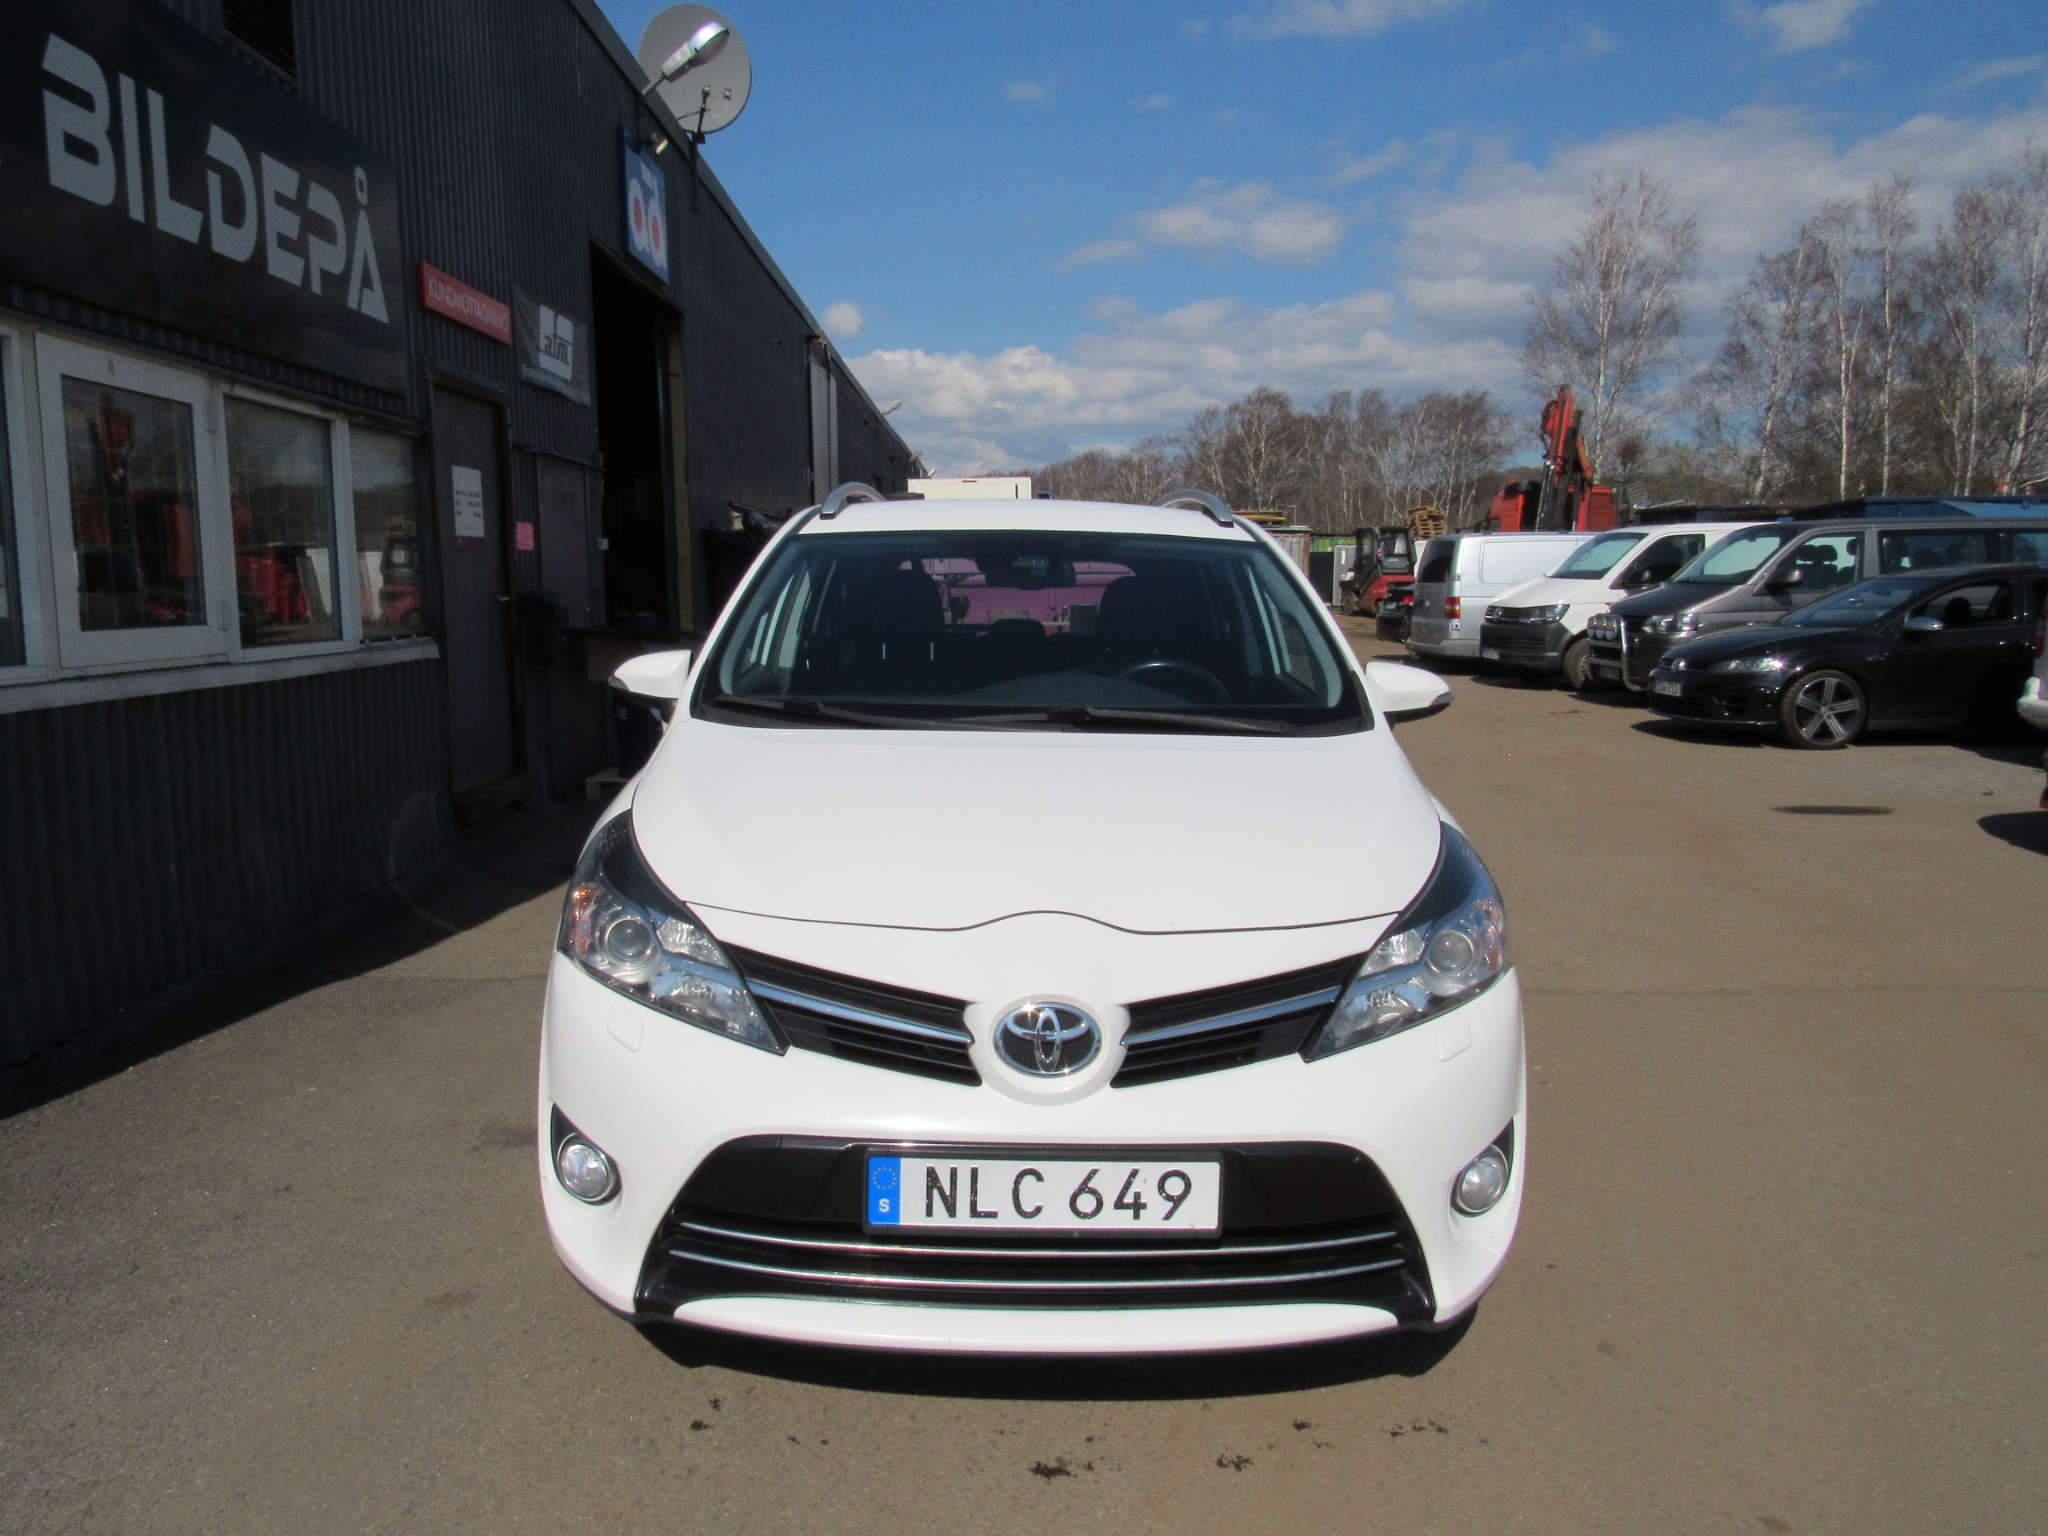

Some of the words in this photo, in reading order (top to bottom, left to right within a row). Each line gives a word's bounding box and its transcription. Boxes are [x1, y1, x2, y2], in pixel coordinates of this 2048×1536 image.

[42, 32, 390, 325] BILDEPÅ
[428, 276, 509, 333] KUNDMOTTAGNING
[878, 1198, 890, 1213] S
[925, 1163, 1044, 1219] NLC
[1068, 1167, 1193, 1221] 649
